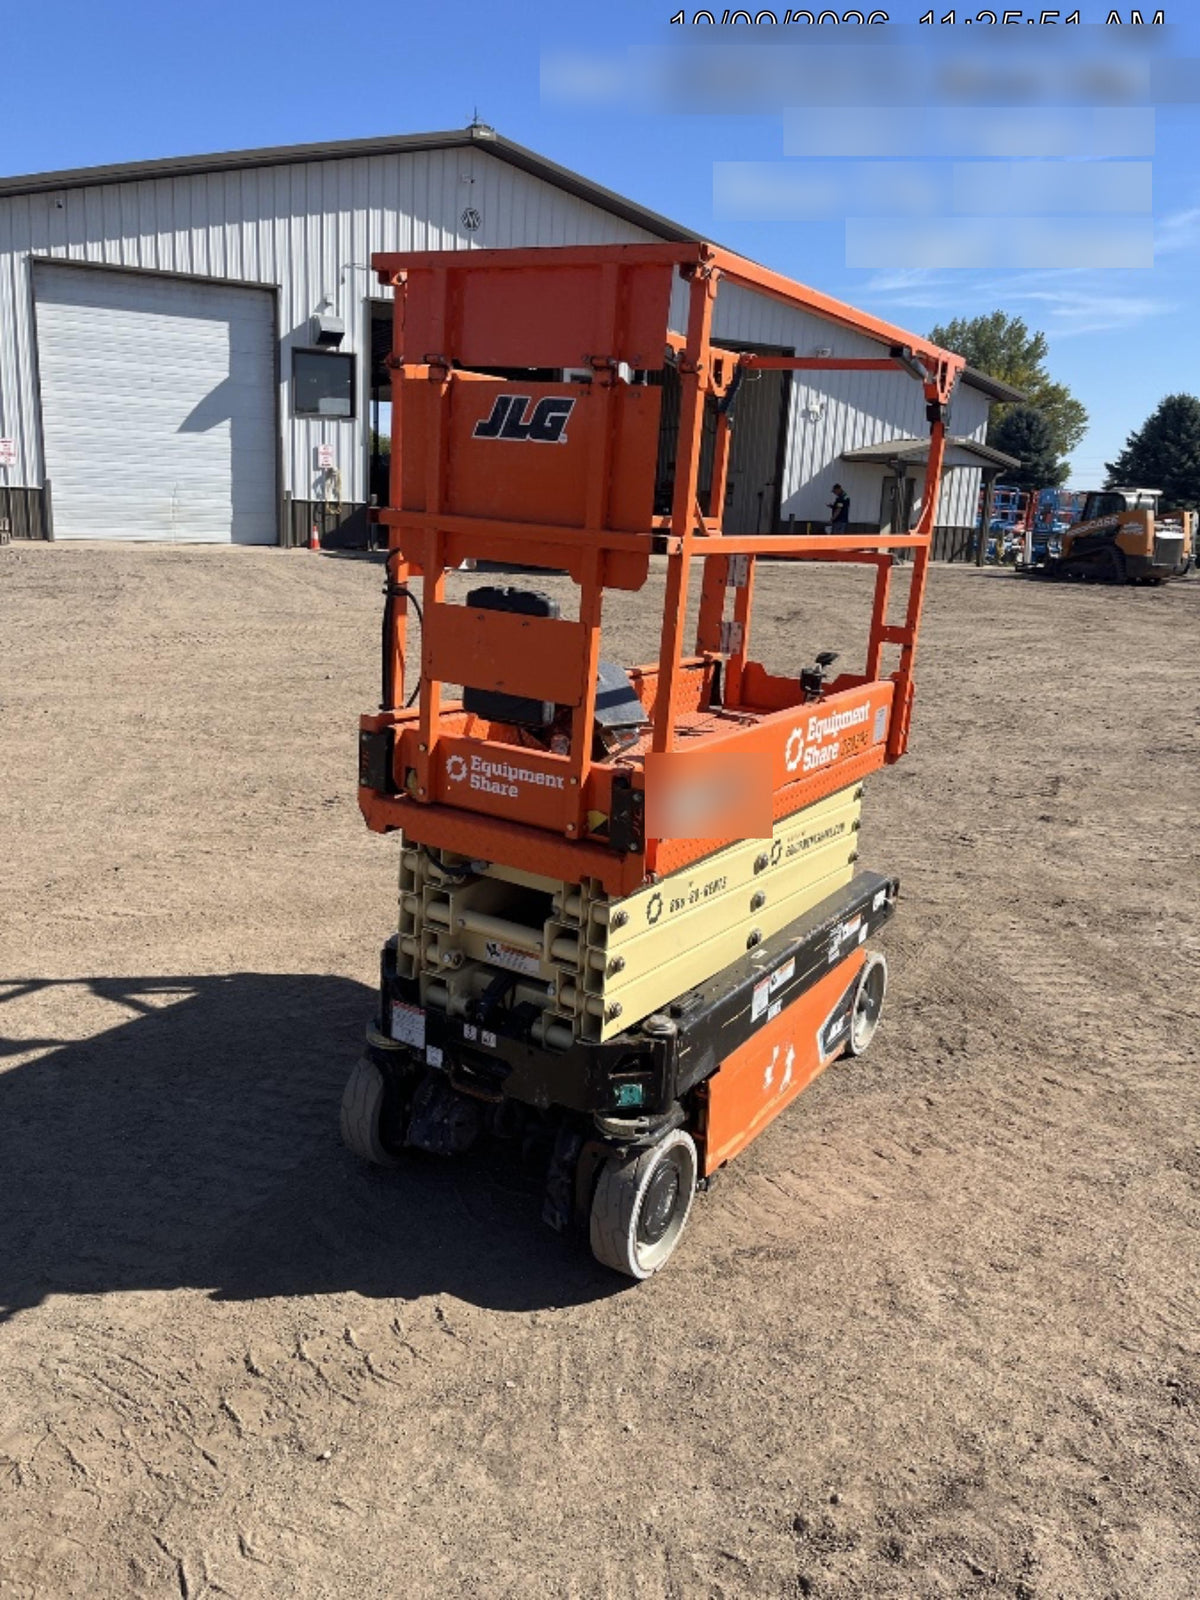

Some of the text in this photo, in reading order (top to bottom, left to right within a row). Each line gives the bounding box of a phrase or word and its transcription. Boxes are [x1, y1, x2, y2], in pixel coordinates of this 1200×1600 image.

[471, 394, 577, 443] JLG
[806, 700, 870, 743] Equipment
[470, 755, 564, 788] Equipment
[803, 742, 840, 771] Share
[470, 774, 518, 797] Share
